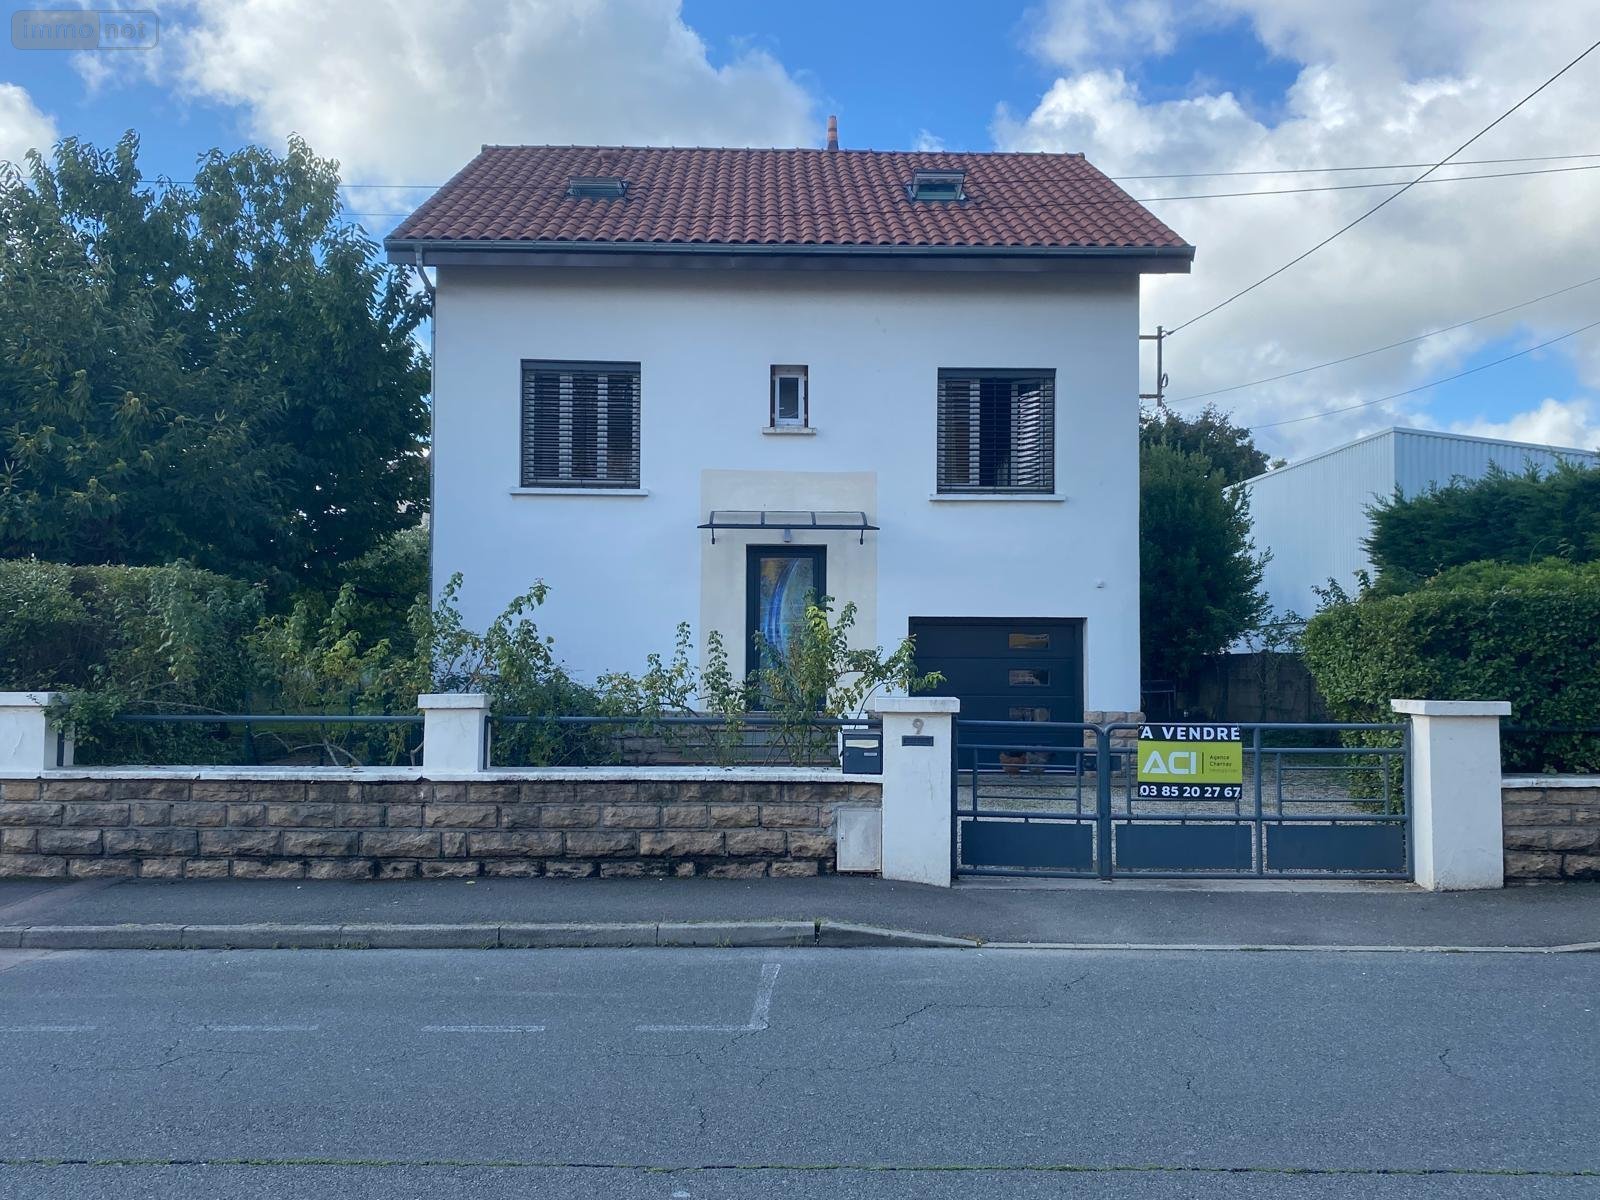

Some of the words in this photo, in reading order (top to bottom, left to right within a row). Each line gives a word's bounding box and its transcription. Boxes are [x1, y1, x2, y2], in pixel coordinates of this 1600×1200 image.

[912, 718, 924, 735] 9
[1161, 726, 1240, 740] VENDRE
[1142, 750, 1197, 775] ACI
[1140, 785, 1157, 796] 03
[1161, 785, 1179, 797] 85
[1182, 786, 1200, 797] 20
[1204, 786, 1220, 797] 27
[1224, 787, 1241, 798] 67
